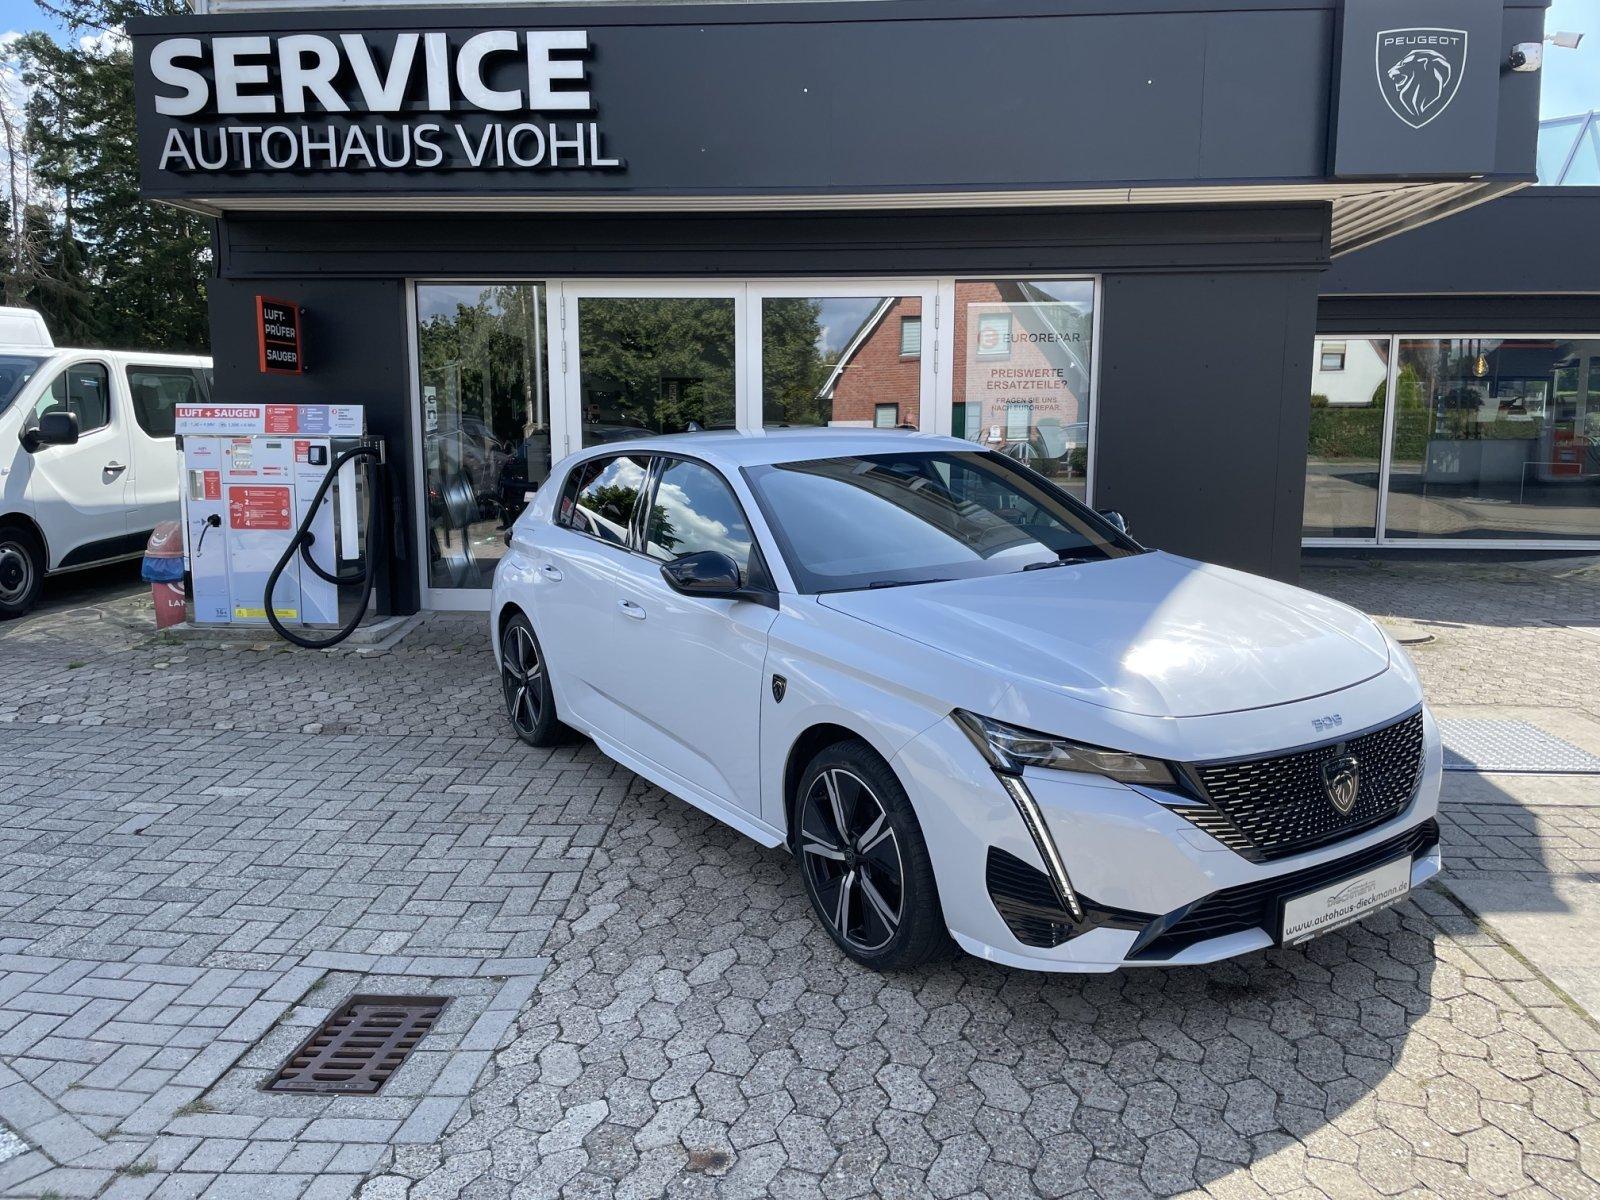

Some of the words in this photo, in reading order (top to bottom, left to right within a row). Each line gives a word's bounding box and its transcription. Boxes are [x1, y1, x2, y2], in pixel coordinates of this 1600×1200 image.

[1384, 36, 1459, 46] PEUGEOT
[150, 30, 590, 116] SERVICE
[158, 124, 442, 171] AUTOHAUS
[455, 122, 620, 167] VIOHL
[264, 308, 286, 321] LUFT-
[265, 323, 296, 338] PRÜFER
[1004, 333, 1080, 343] EUROREPAR
[266, 349, 298, 363] SAUGER
[991, 368, 1064, 378] PREISWERTE
[986, 380, 1068, 390] ERSATZTEILE?
[179, 409, 203, 417] LUFT
[214, 409, 257, 418] SAUGEN
[1285, 882, 1408, 935] www.autohaus-dieckmann.de
